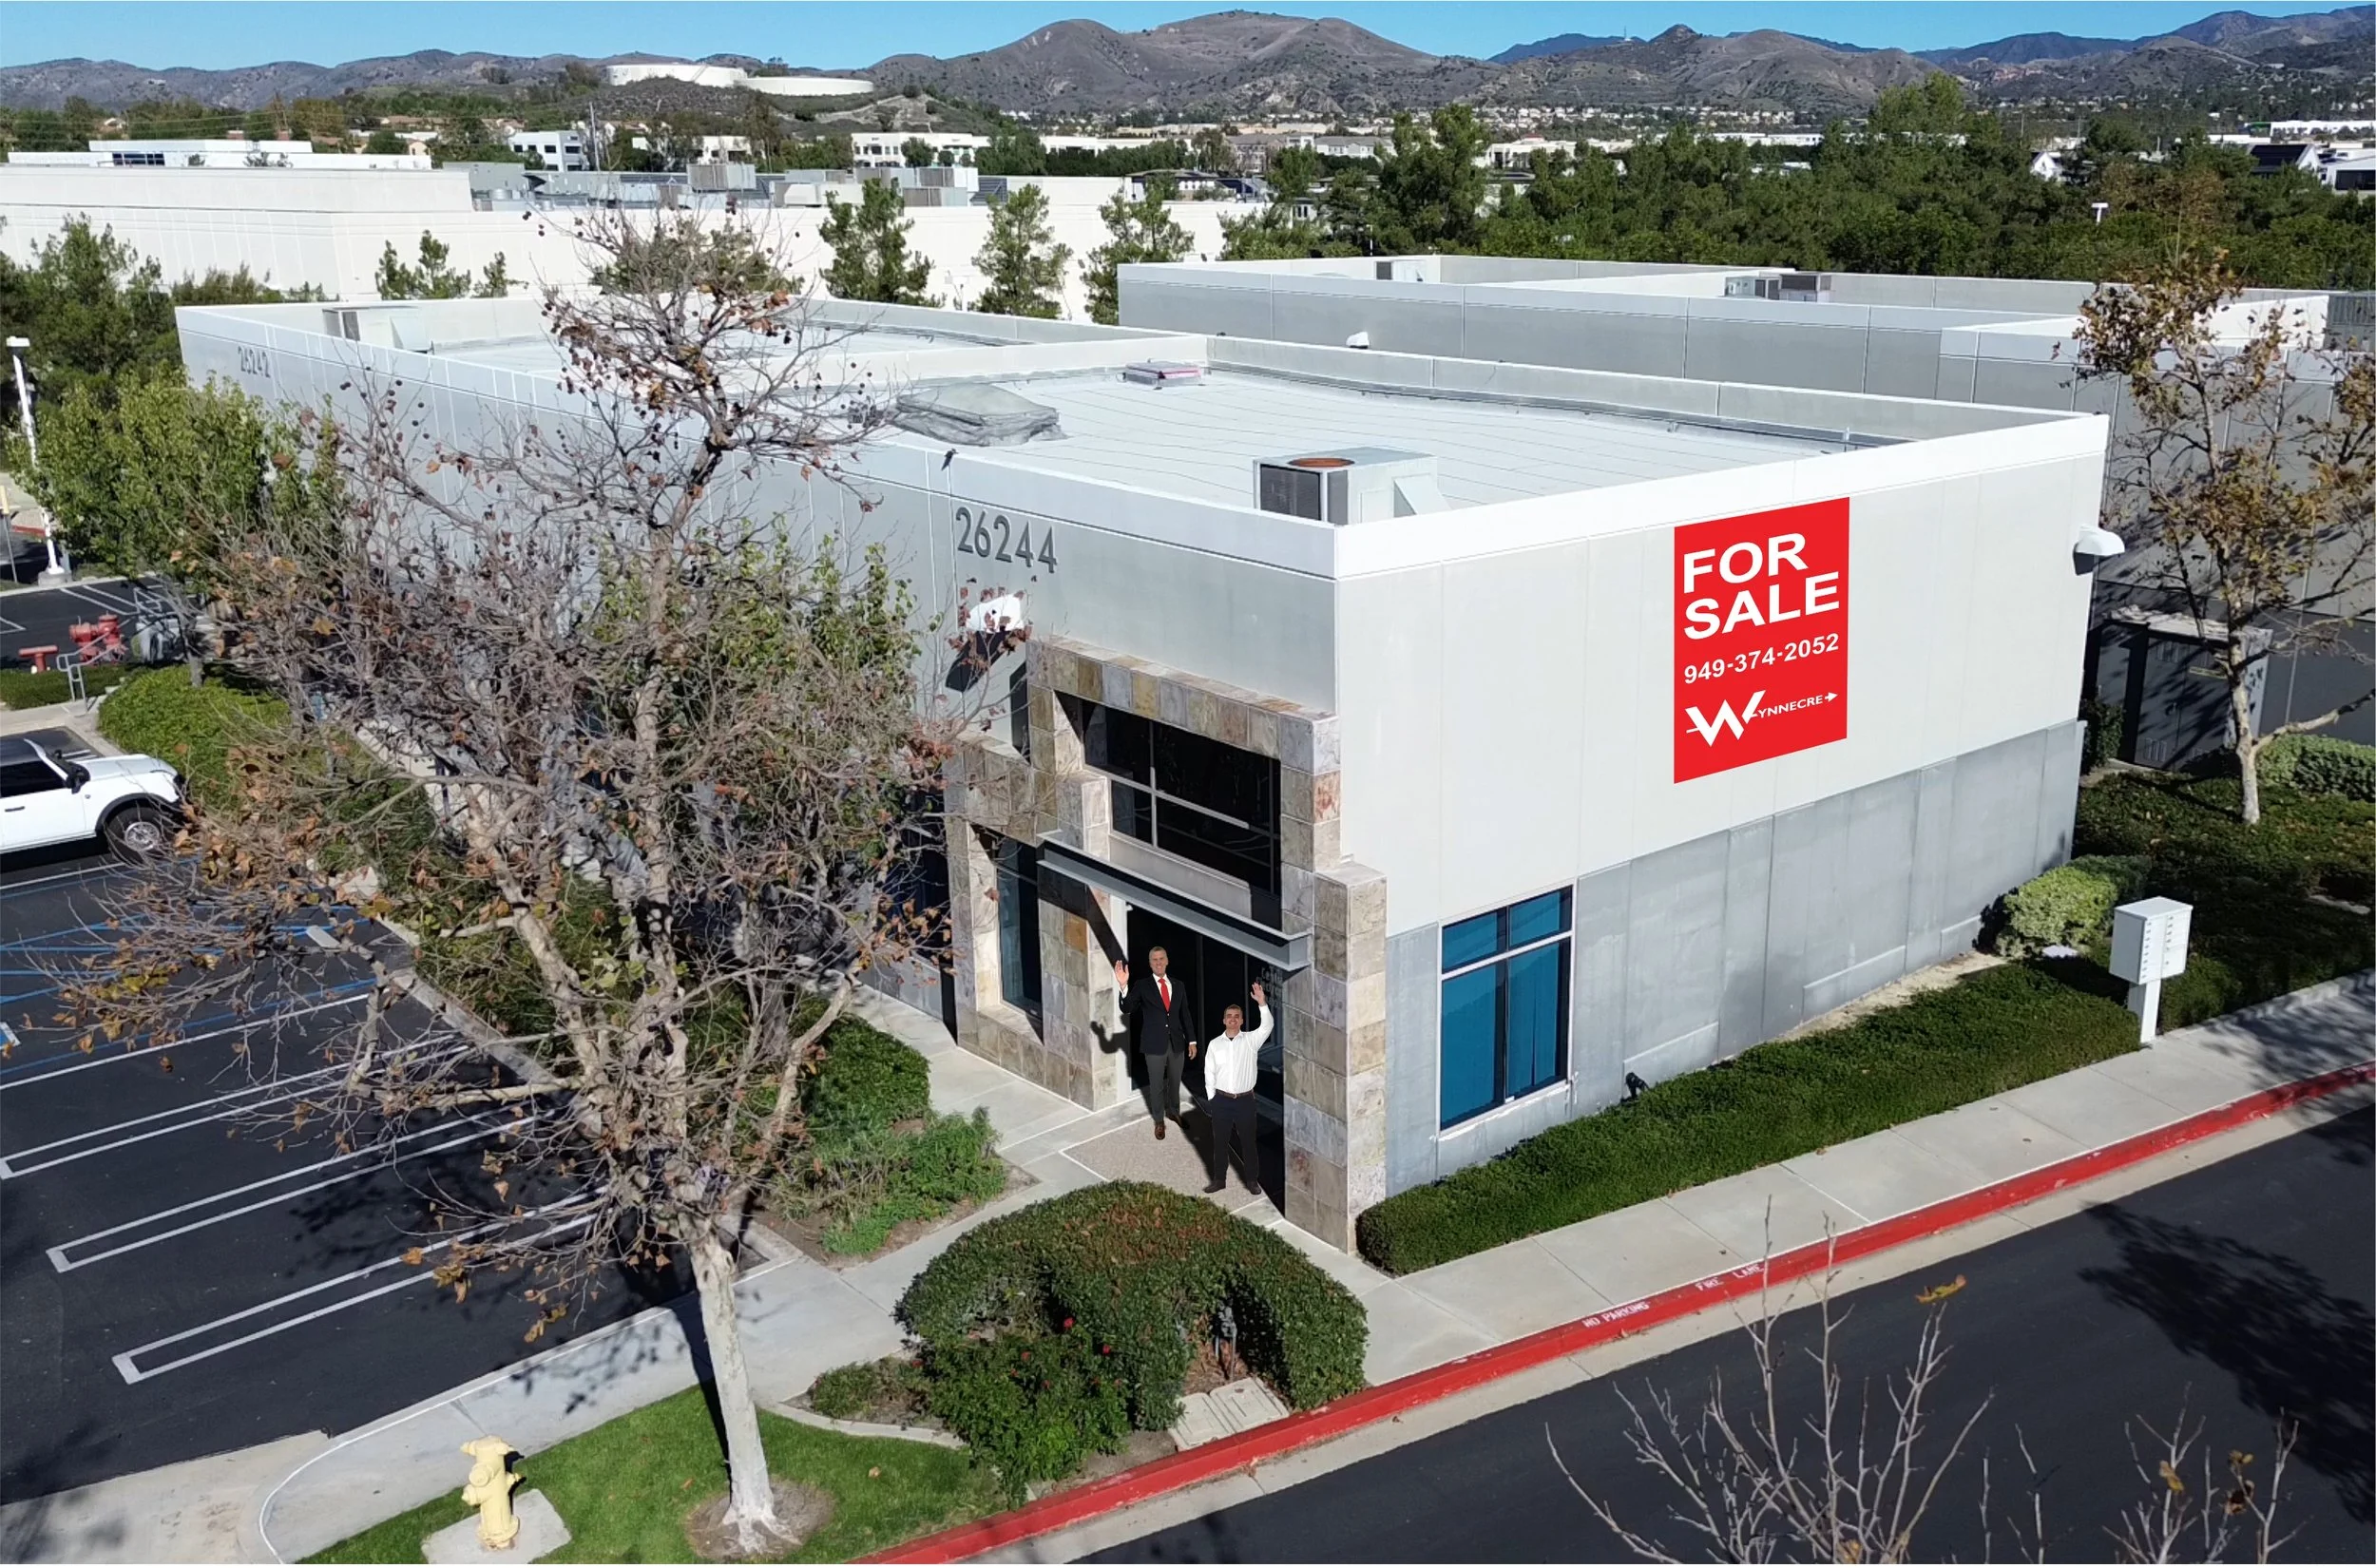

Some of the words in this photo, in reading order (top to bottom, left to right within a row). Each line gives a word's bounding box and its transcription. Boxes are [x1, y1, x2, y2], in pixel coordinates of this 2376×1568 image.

[238, 346, 271, 378] 26242
[955, 507, 1057, 574] 26244
[1683, 532, 1809, 594] FOR
[1684, 571, 1840, 641] SALE
[1684, 633, 1839, 684] 949-374-2052
[1581, 1316, 1601, 1329] NO
[1600, 1300, 1651, 1323] PARKING
[1732, 1263, 1765, 1279] LANE
